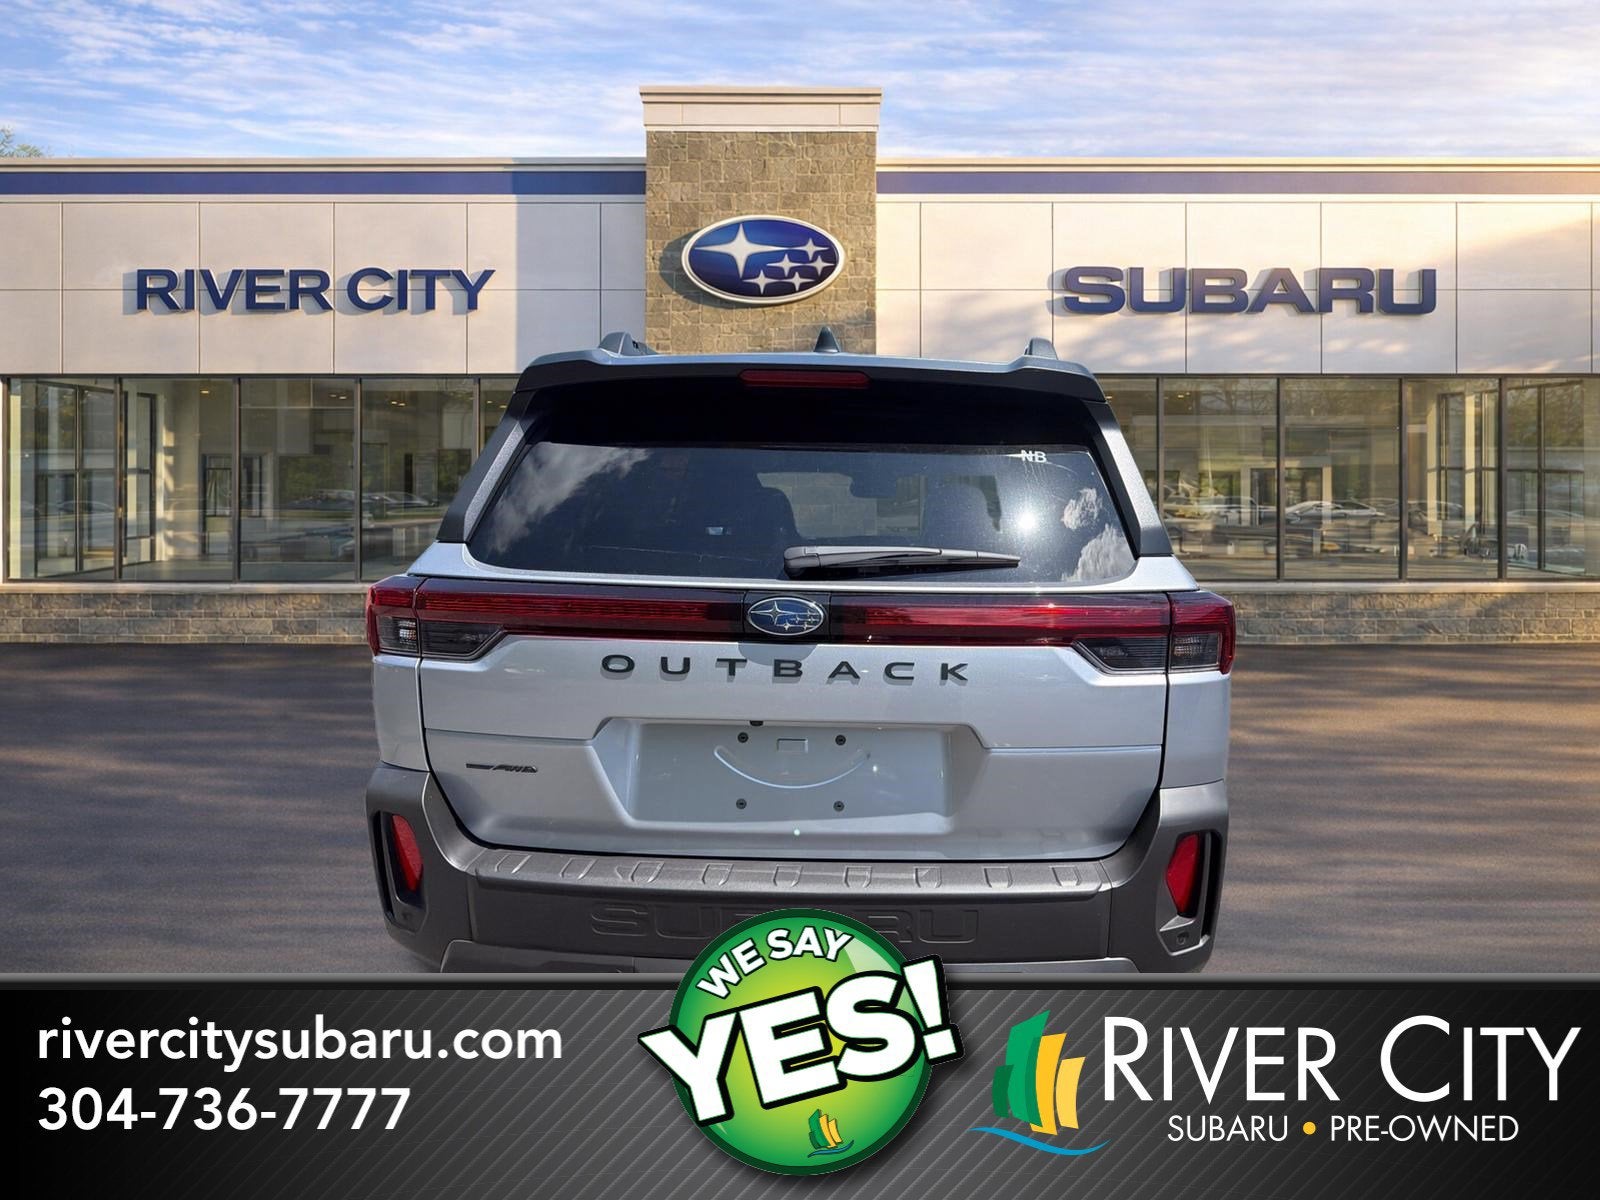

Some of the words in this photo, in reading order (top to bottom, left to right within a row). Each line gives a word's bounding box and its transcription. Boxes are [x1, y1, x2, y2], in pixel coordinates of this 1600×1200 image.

[136, 268, 333, 311] RIVER
[346, 267, 496, 311] CITY
[1063, 266, 1437, 315] SUBARU
[1021, 450, 1047, 462] NB
[601, 654, 969, 682] OUTBACK
